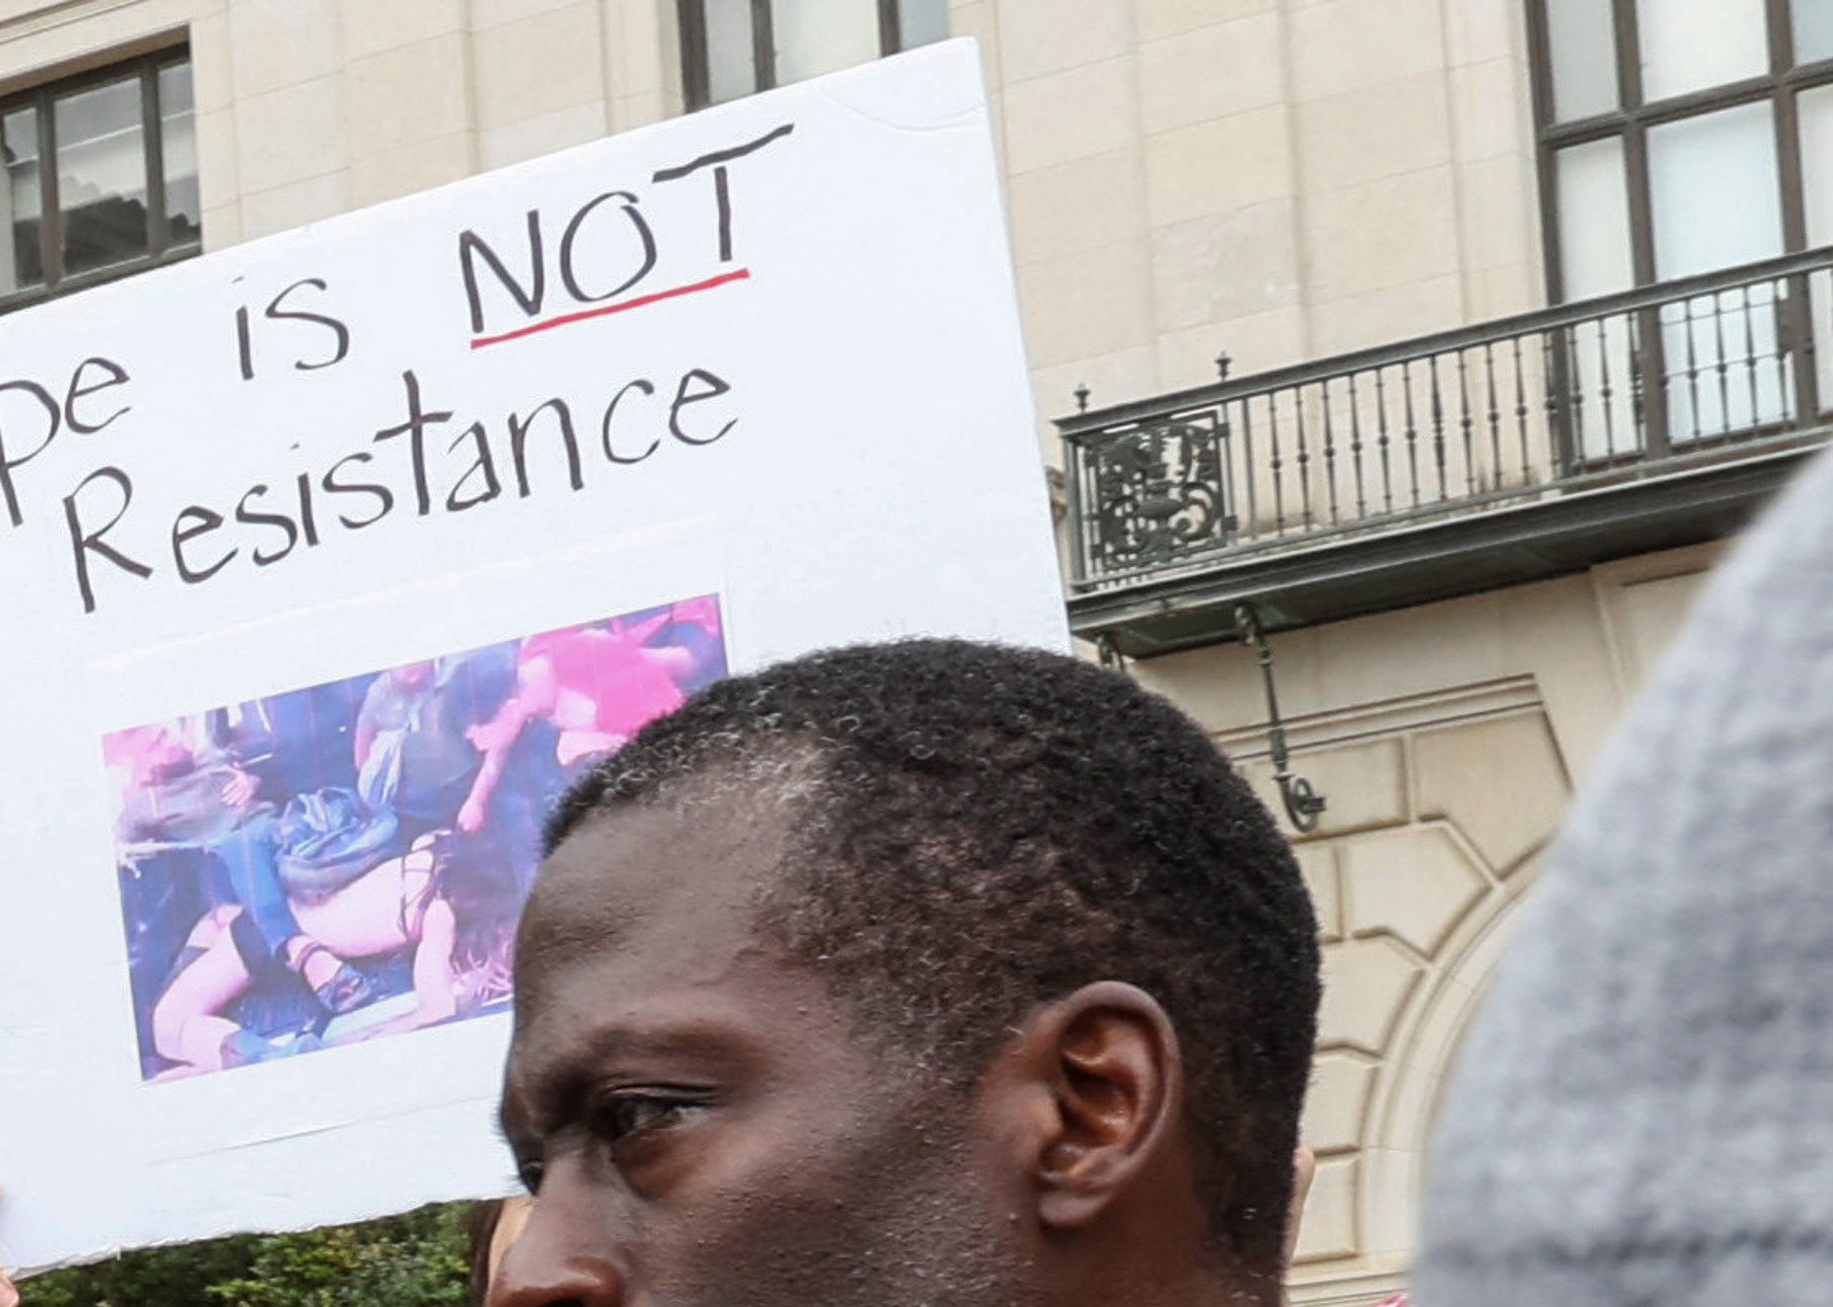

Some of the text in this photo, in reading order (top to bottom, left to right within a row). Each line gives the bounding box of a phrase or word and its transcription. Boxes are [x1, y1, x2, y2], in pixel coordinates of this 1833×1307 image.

[231, 276, 350, 383] is
[458, 123, 795, 335] NOT
[63, 367, 738, 614] Resistance
